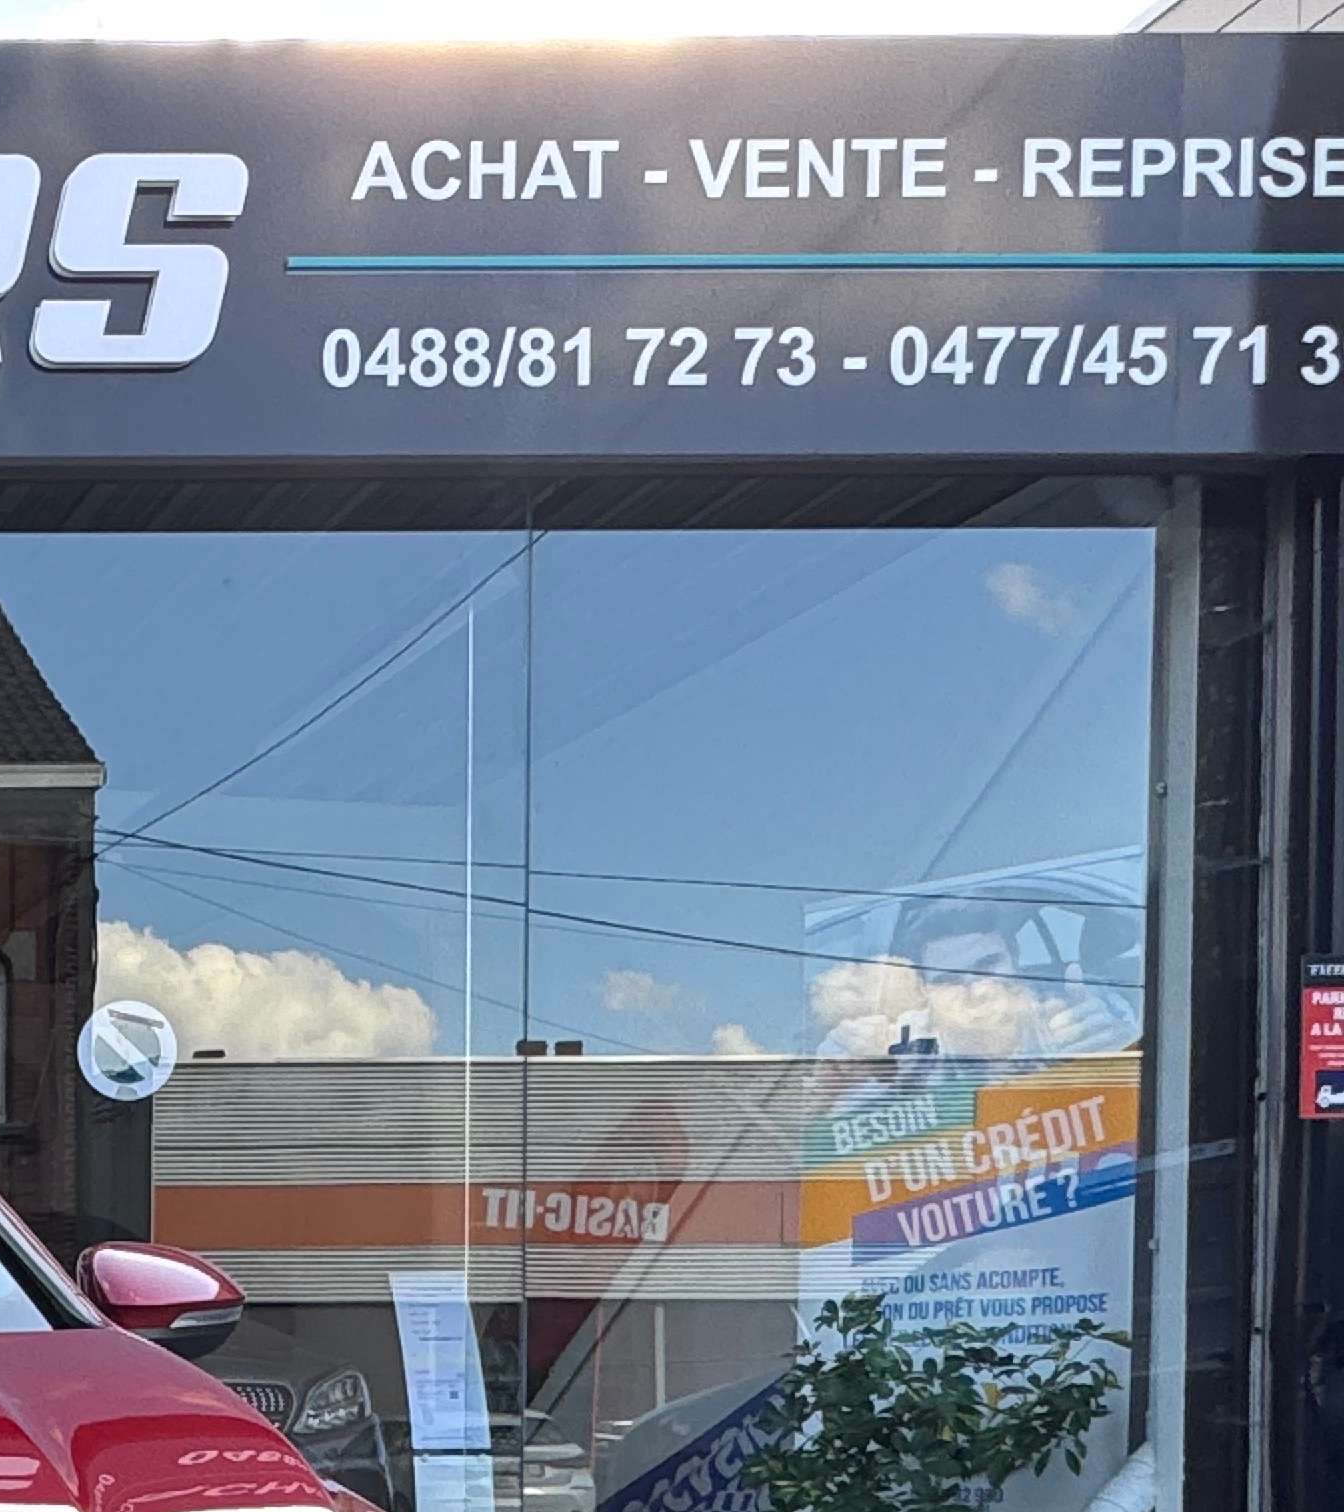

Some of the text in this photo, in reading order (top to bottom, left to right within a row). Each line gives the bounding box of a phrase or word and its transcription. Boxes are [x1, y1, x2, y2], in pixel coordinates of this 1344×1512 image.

[351, 136, 1344, 200] ACHAT - VENTE - REPRISE
[323, 327, 591, 387] 0488/81
[626, 327, 707, 385] 72
[735, 327, 815, 385] 73
[843, 357, 867, 369] -
[891, 325, 1167, 385] 0477/45
[1194, 326, 1265, 384] 71
[831, 1094, 939, 1154] BESOIN
[864, 1094, 1106, 1202] D'UN CRÉDIT
[897, 1174, 1053, 1247] VOITURE
[904, 1273, 926, 1294] OU
[929, 1270, 972, 1292] SANS
[976, 1266, 1065, 1291] ACOMPTE,
[909, 1301, 930, 1320] DU
[933, 1297, 974, 1319] PRÊT
[980, 1297, 1026, 1318] VOUS
[1030, 1292, 1108, 1316] PROPOSE
